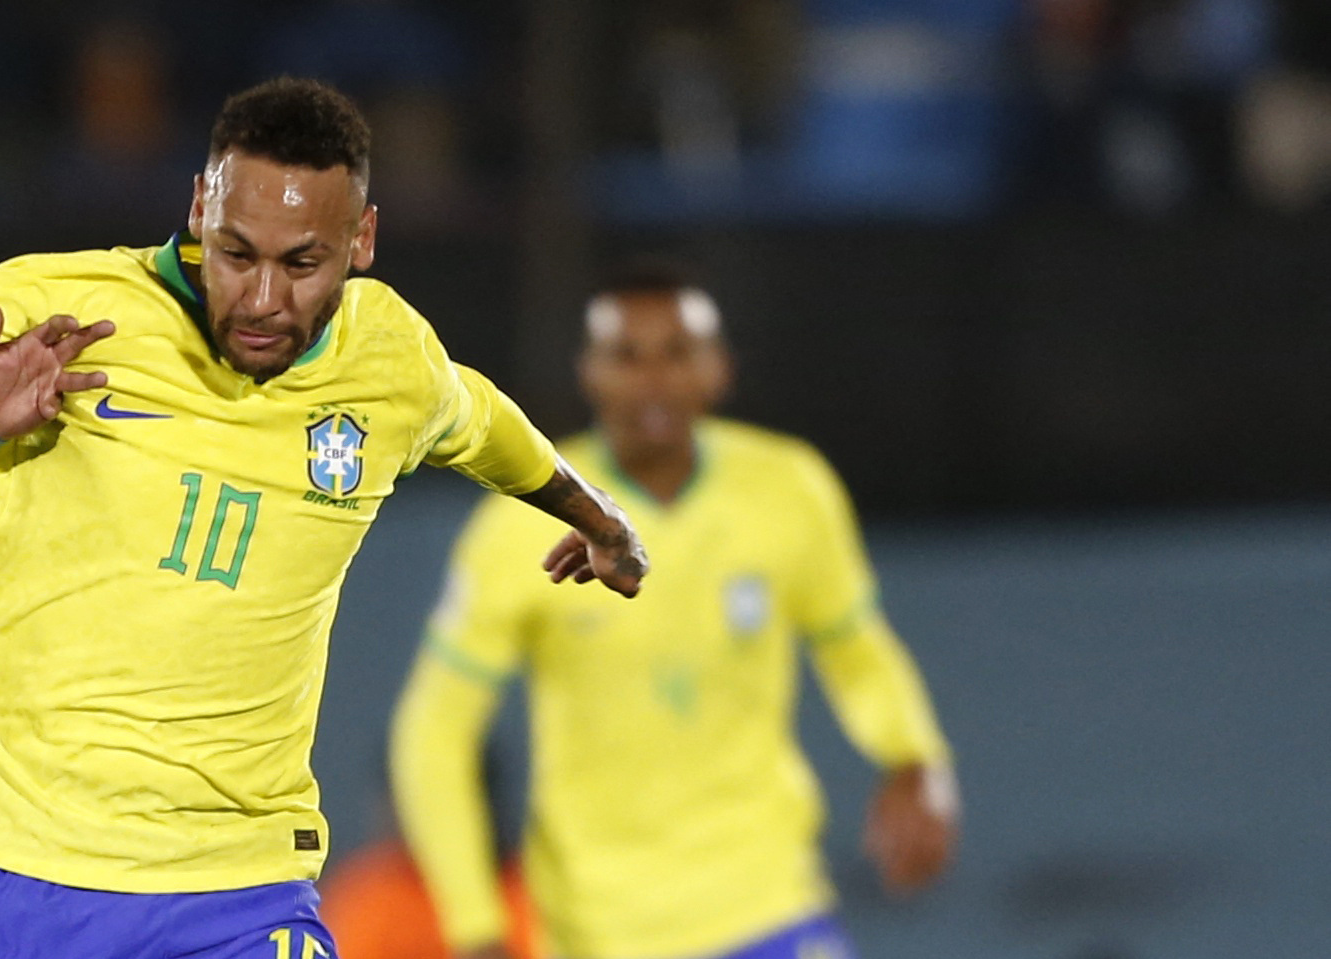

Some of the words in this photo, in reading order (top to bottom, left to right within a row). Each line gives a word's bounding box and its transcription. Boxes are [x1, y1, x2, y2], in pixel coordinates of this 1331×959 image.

[324, 448, 348, 459] CBF
[303, 490, 360, 510] BRASIL
[158, 472, 262, 590] 10
